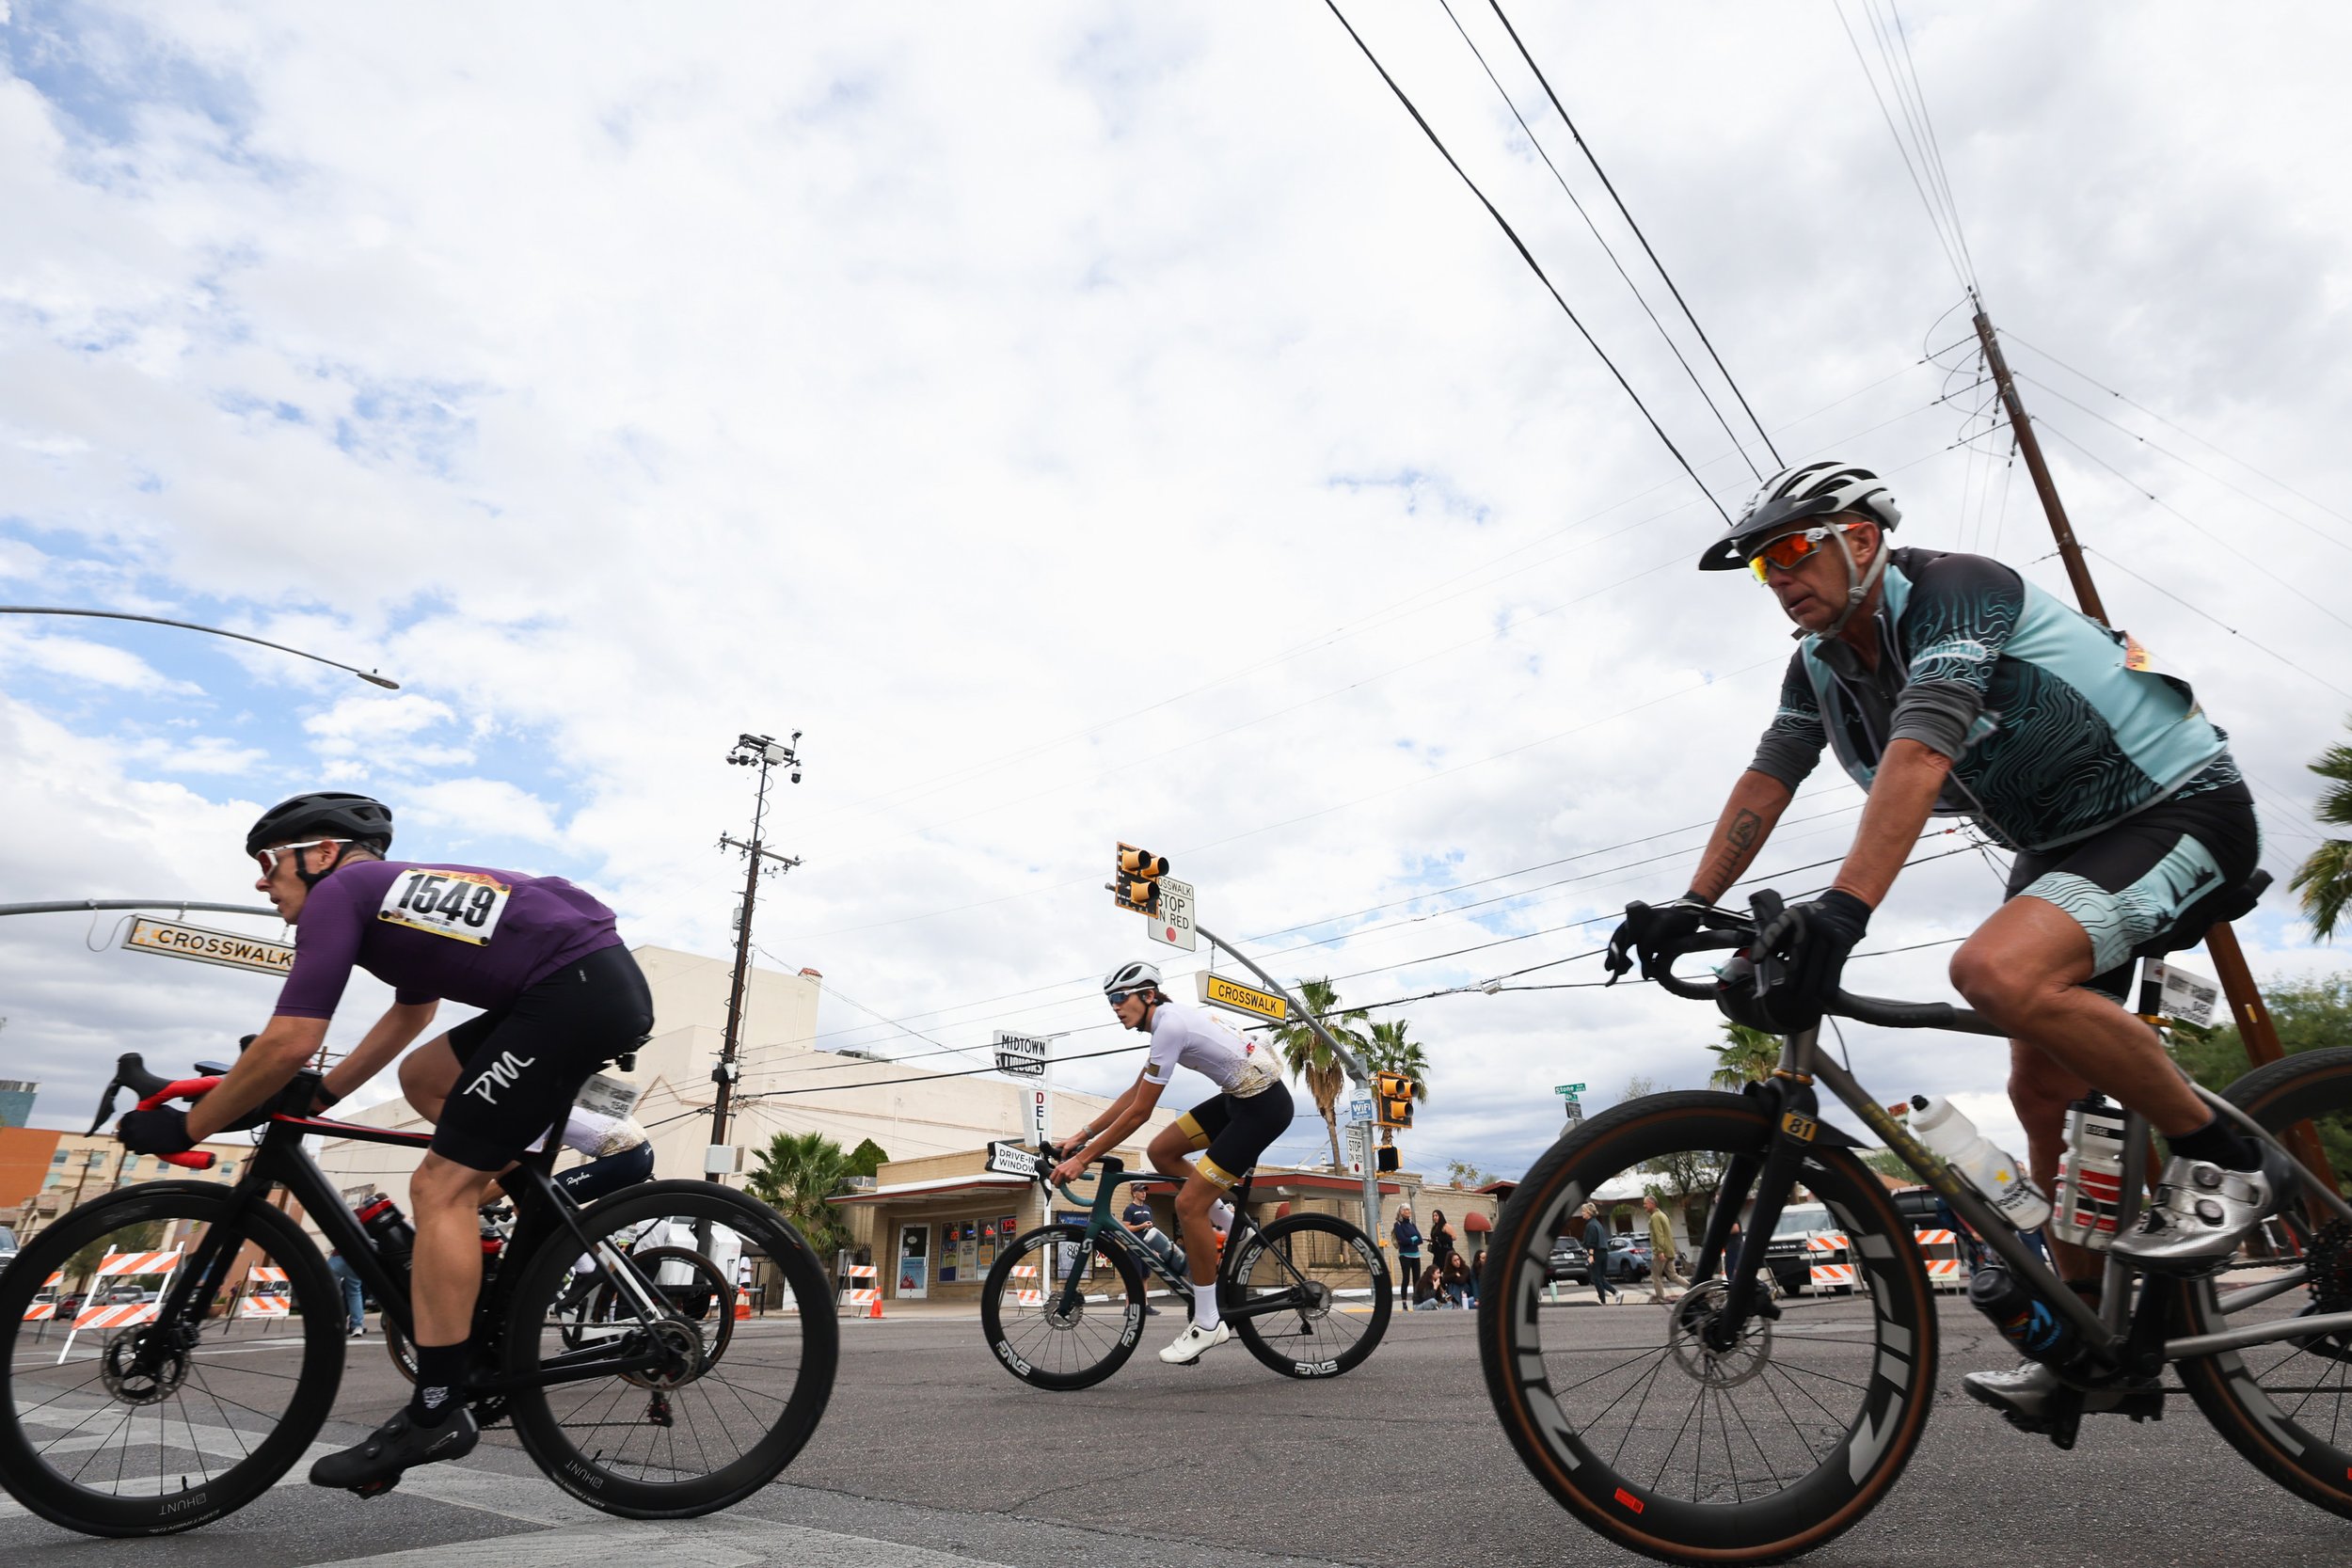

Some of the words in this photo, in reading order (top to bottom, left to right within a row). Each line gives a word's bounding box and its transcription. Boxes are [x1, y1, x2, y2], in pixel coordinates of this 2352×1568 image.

[1158, 877, 1192, 897] OSSWALK
[397, 874, 497, 928] 1549
[1158, 893, 1185, 913] STOP
[1169, 913, 1189, 929] RED
[158, 930, 294, 967] CROSSWALK
[1218, 984, 1277, 1014] CROSSWALK
[1002, 1035, 1045, 1055] MIDTOWN
[1005, 1055, 1043, 1075] LIQUORS
[1036, 1091, 1044, 1143] DELI
[1349, 1139, 1361, 1152] STOP
[999, 1158, 1036, 1174] WINDOW
[1114, 1230, 1196, 1298] SCOTT
[565, 1460, 596, 1485] HUNT
[159, 1497, 196, 1516] HUNT
